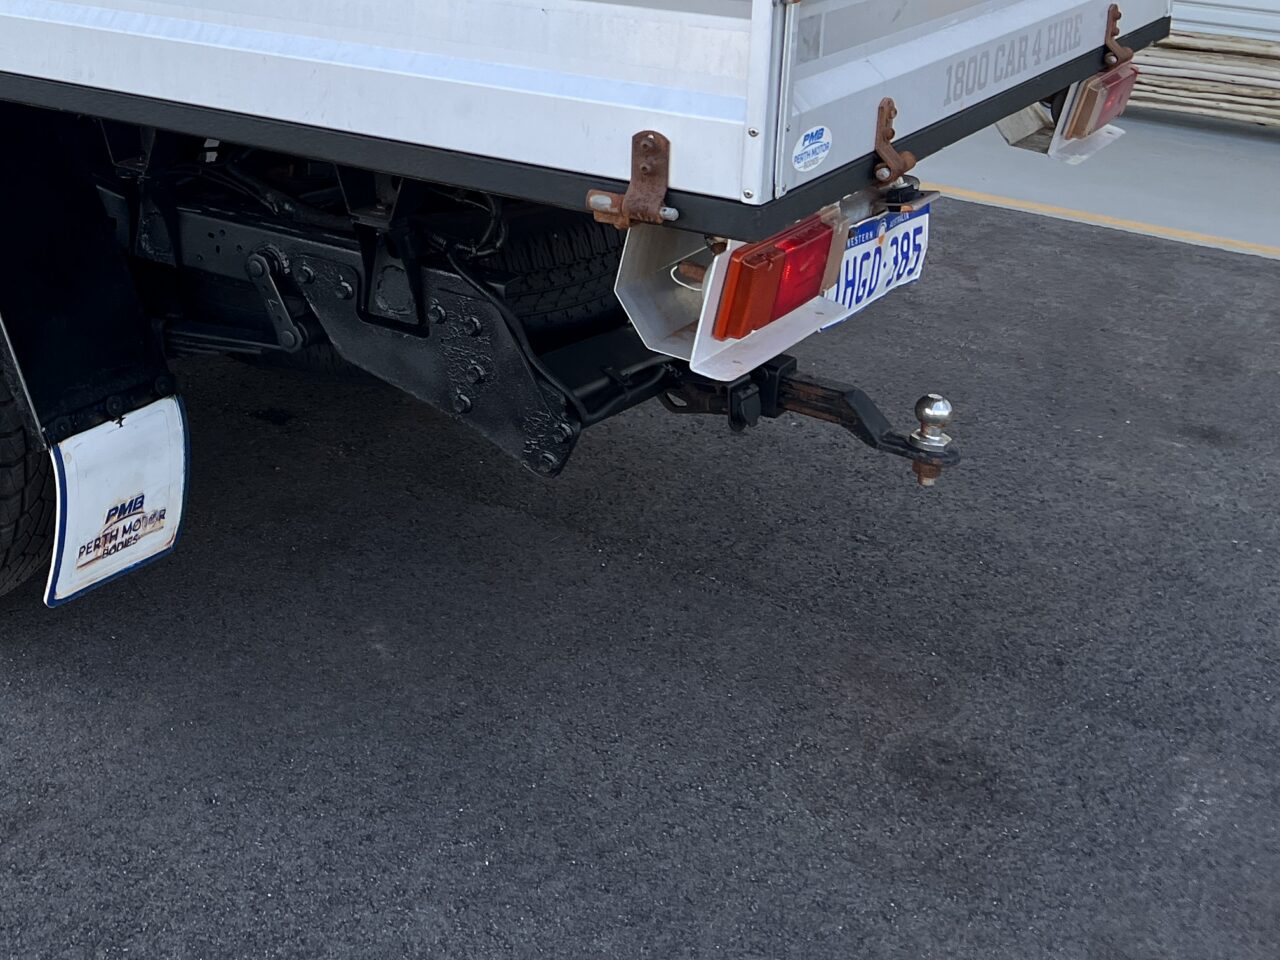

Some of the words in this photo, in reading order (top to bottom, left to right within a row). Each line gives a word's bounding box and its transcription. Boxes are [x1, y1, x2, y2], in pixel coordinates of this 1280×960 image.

[943, 48, 991, 107] 1800
[993, 34, 1029, 84] CAR
[1031, 28, 1043, 67] 4
[1045, 13, 1084, 62] HIRE
[802, 127, 825, 147] PMB
[105, 494, 145, 524] PMB
[78, 528, 119, 558] PERTH
[102, 534, 139, 559] BODIES
